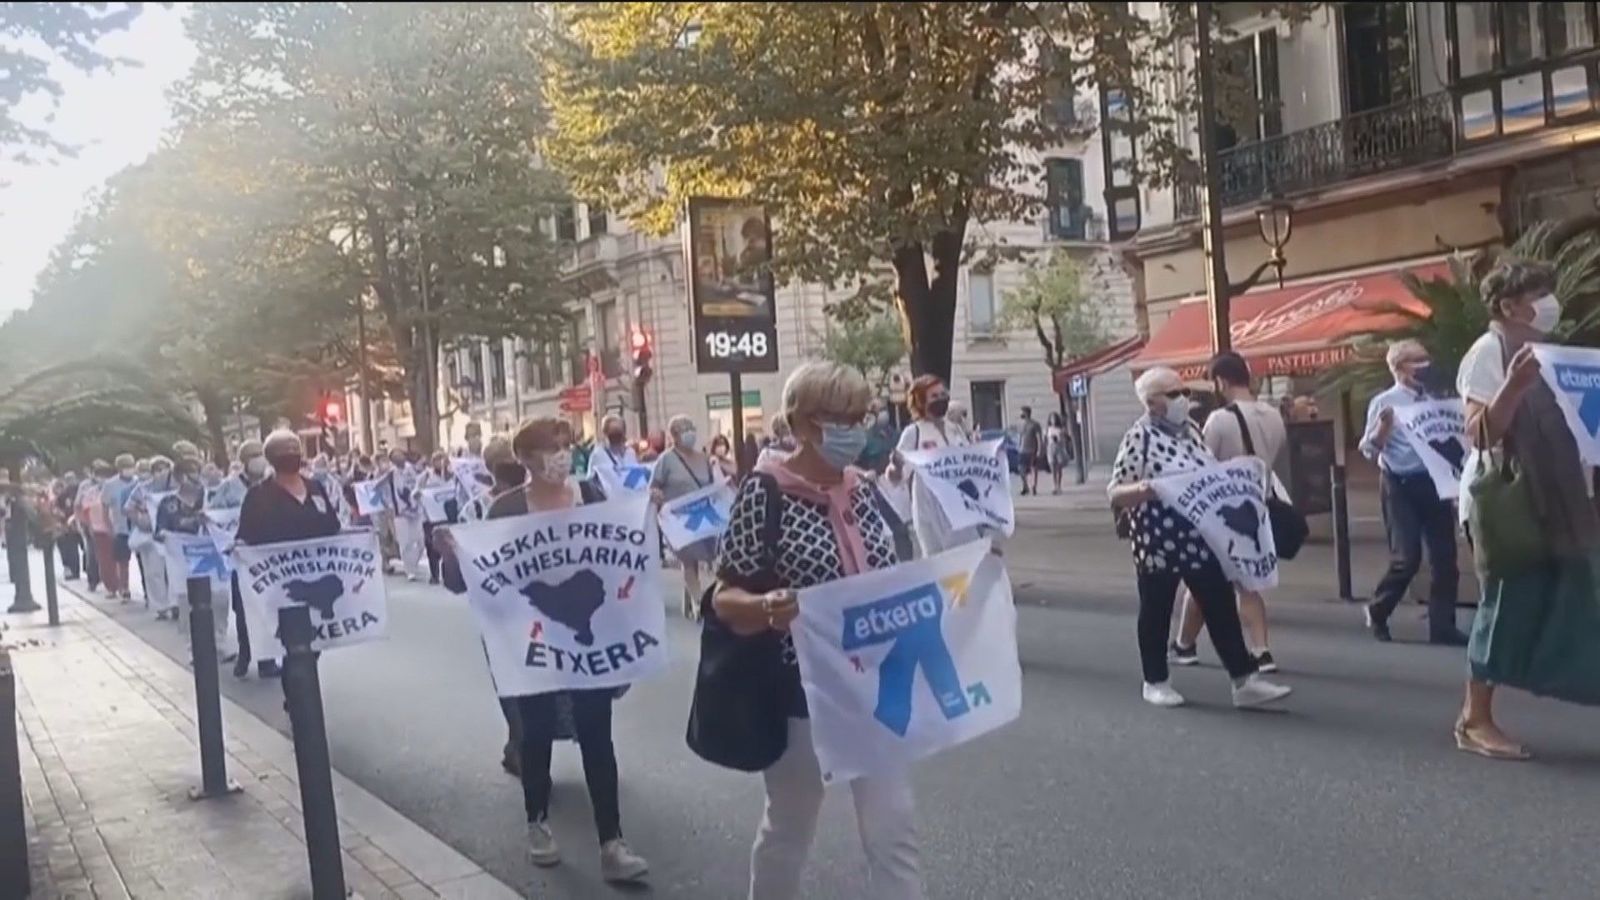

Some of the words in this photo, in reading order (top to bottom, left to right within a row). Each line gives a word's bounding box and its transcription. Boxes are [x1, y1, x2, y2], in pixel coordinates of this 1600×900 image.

[705, 332, 768, 357] 19:48
[249, 548, 312, 577] EUSKAL
[317, 546, 374, 562] PRESO
[472, 525, 561, 571] USKAL
[568, 522, 646, 546] PRESO
[514, 546, 650, 580] IHESLARIAK
[252, 571, 279, 594] ETA
[280, 560, 376, 578] IHESLARIAK
[525, 629, 659, 676] ETXERA
